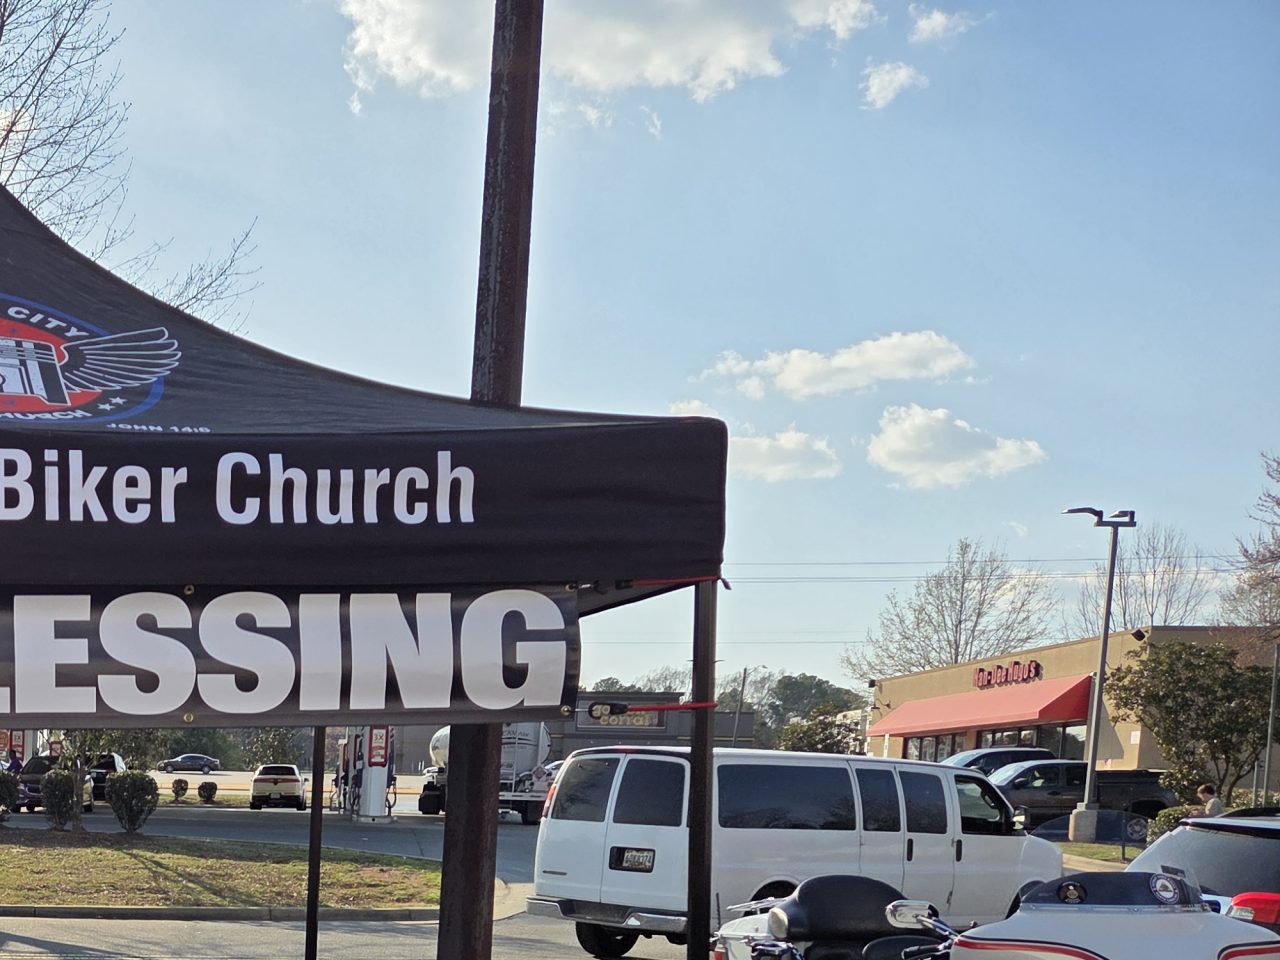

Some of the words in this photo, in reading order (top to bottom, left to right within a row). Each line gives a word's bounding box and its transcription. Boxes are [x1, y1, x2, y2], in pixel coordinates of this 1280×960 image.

[8, 307, 89, 338] CITY
[106, 423, 163, 432] JOHN
[216, 450, 476, 525] Church
